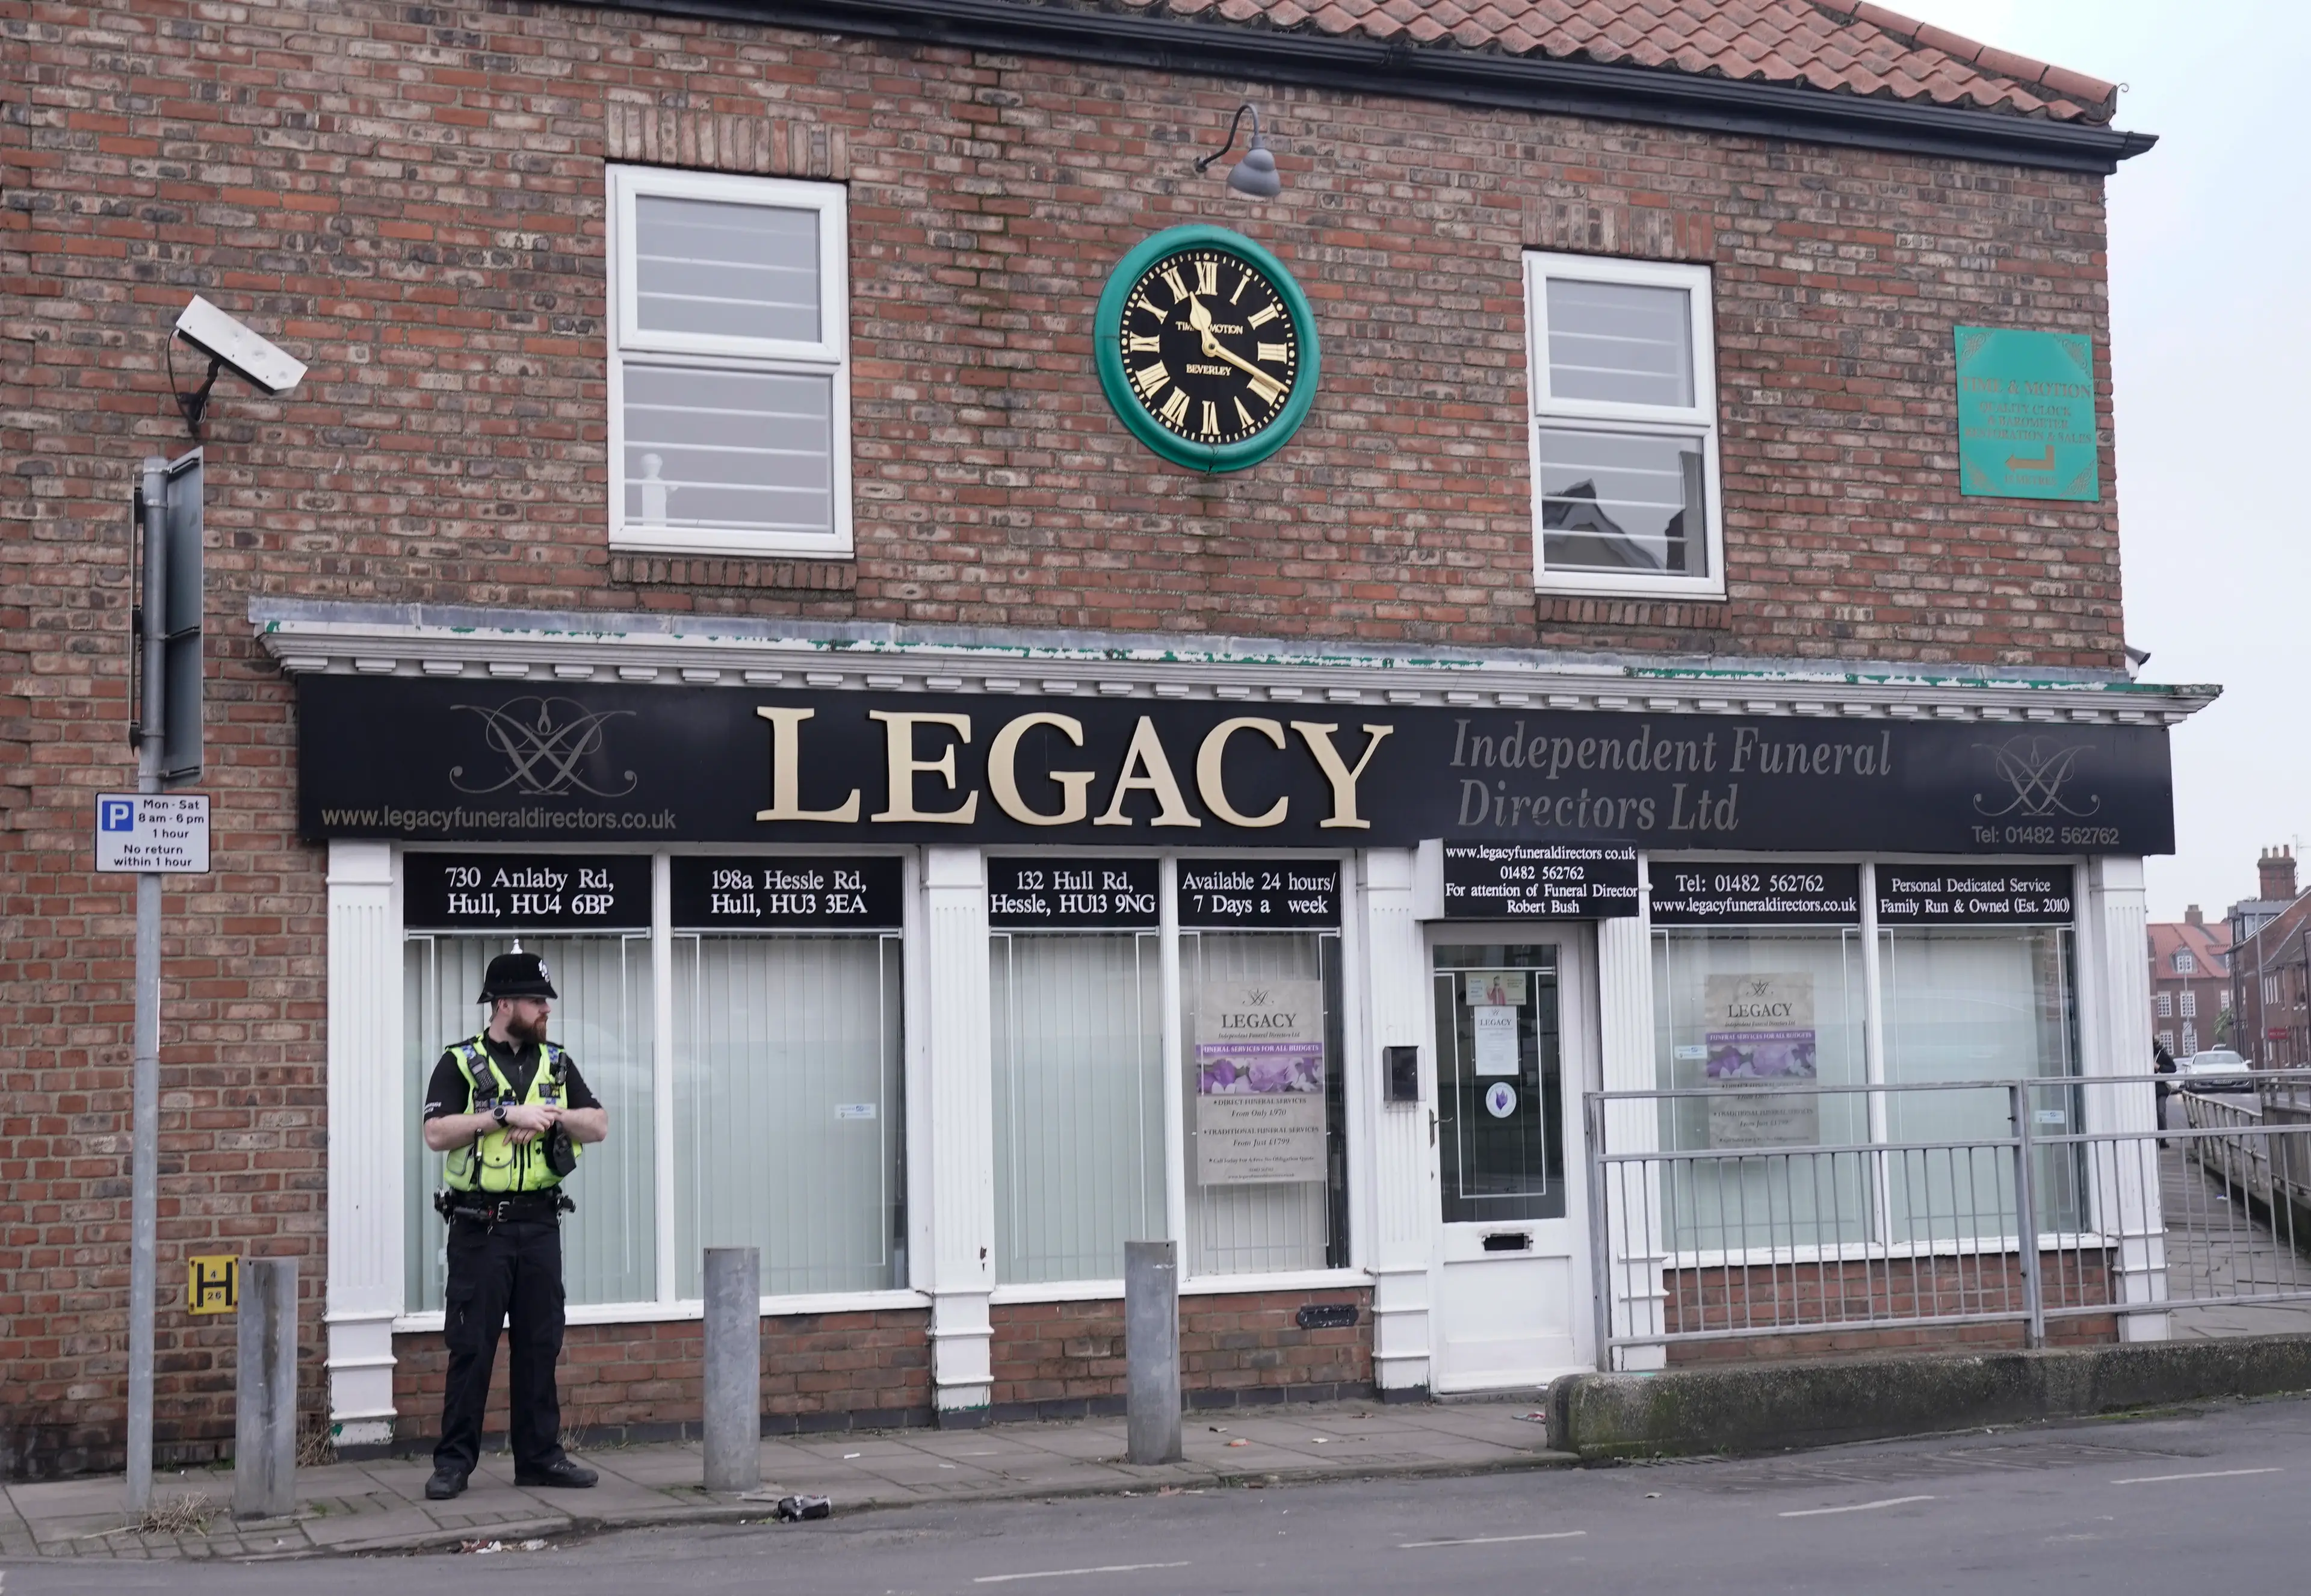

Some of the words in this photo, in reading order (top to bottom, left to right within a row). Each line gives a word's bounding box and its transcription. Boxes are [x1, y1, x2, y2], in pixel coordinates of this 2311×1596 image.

[1161, 266, 1189, 305] XI
[1195, 261, 1219, 296] XII
[1137, 293, 1168, 324] X
[1175, 321, 1195, 331] TIM
[1209, 324, 1243, 335] MOTION
[1186, 364, 1232, 376] BEVERLEY
[1961, 376, 2003, 392] TIME
[2008, 380, 2019, 394] &
[2025, 380, 2091, 398] MOTION
[1980, 401, 2031, 413] QUALITY
[2033, 404, 2071, 416] CLOCK
[1999, 416, 2069, 429] BAROMETER
[1964, 427, 2044, 440] RESTORATION
[2058, 432, 2091, 443] SALES
[1450, 719, 1717, 779] Independent
[1729, 727, 1891, 775] Funeral
[755, 705, 1394, 829] LEGACY
[144, 799, 169, 809] Mon
[179, 800, 200, 809] Sat
[1458, 779, 1655, 830] Directors
[1668, 783, 1739, 830] Ltd
[110, 803, 129, 829] P
[138, 813, 145, 823] 8
[176, 814, 183, 823] 6
[187, 815, 204, 824] pm
[321, 805, 676, 832] www.legacyfuneraldirectors.co.uk
[153, 829, 157, 838] 1
[162, 829, 189, 838] hour
[1972, 826, 1999, 843] Tel:
[2005, 826, 2055, 843] 01482
[2061, 827, 2120, 844] 562762
[124, 844, 140, 854] No
[146, 845, 183, 854] return
[114, 856, 150, 867] within
[156, 858, 159, 866] 1
[166, 857, 192, 867] hour
[445, 867, 481, 888] 730
[492, 867, 568, 892] Anlaby
[578, 868, 614, 892] Rd,
[712, 870, 754, 889] 198a
[764, 870, 824, 889] Hessle
[833, 870, 867, 893] Rd,
[1500, 865, 1535, 880] 01482
[1542, 866, 1585, 880] 562762
[1017, 871, 1044, 890] 132
[1053, 871, 1094, 890] Hull
[1103, 871, 1133, 893] Rd,
[1183, 871, 1254, 891] Available
[1261, 872, 1281, 891] 24
[1288, 872, 1336, 893] hours/
[1445, 883, 1465, 897] For
[1471, 883, 1521, 897] attention
[1526, 883, 1538, 897] of
[1544, 883, 1587, 897] Funeral
[1592, 884, 1638, 897] Director
[1675, 874, 1706, 892] Tel:
[1715, 874, 1760, 892] 01482
[1769, 874, 1824, 892] 562762
[1892, 877, 1941, 892] Personal
[1947, 878, 2005, 892] Dedicated
[2010, 877, 2051, 892] Service
[448, 893, 500, 917] Hull,
[511, 894, 562, 914] HU4
[572, 894, 614, 914] 6BP
[711, 893, 761, 917] Hull,
[770, 894, 816, 914] HU3
[826, 894, 868, 914] 3EA
[991, 894, 1051, 917] Hessle,
[1059, 894, 1107, 914] HU13
[1115, 894, 1156, 914] 9NG
[1193, 895, 1204, 913] 7
[1211, 895, 1252, 917] Days
[1260, 900, 1271, 914] a
[1287, 895, 1328, 914] week
[1507, 900, 1545, 914] Robert
[1551, 899, 1580, 914] Bush
[1653, 897, 1857, 915] www.legacyfuneraldirectors.co.uk
[1880, 899, 1919, 916] Family
[1925, 899, 1949, 913] Run
[1954, 899, 1965, 913] &
[1969, 899, 2009, 913] Owned
[2014, 897, 2039, 914] (Est.
[2043, 897, 2070, 914] 2010)
[1728, 1003, 1792, 1018] LEGACY
[1222, 1013, 1297, 1028] LEGACY
[1251, 1109, 1267, 1118] Only
[1208, 1127, 1256, 1136] TRADITIONAL
[1253, 1139, 1266, 1148] Just
[197, 1262, 232, 1307] H
